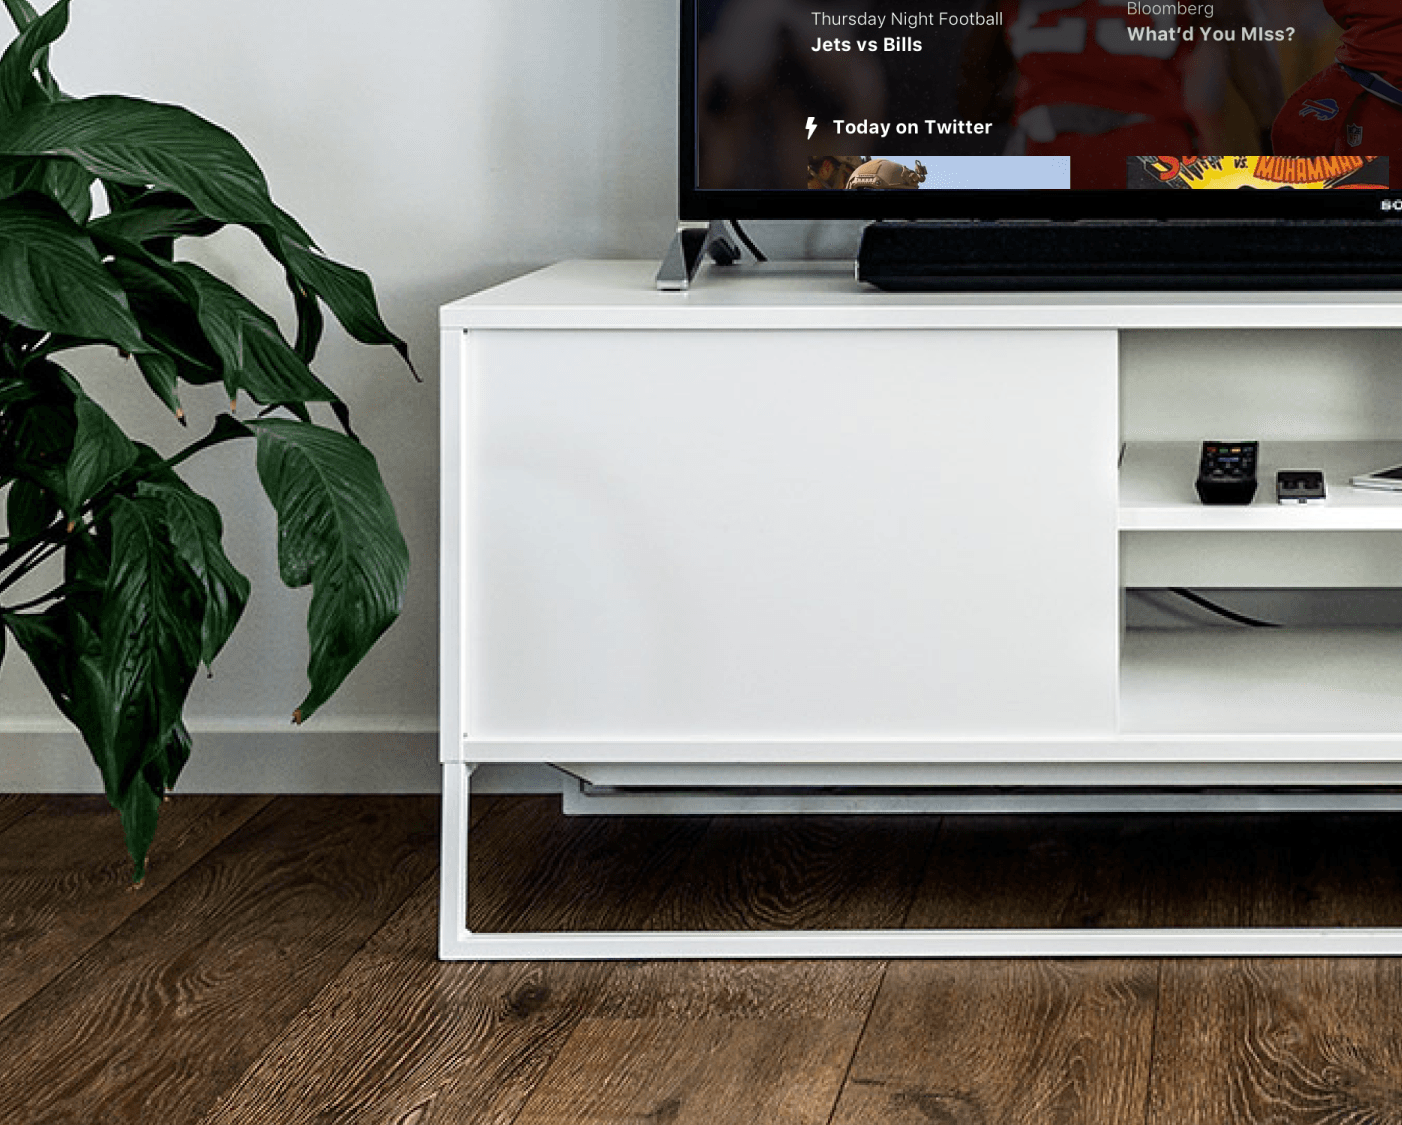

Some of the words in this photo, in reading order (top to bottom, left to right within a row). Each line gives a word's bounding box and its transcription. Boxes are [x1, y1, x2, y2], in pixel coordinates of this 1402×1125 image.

[1127, 1, 1214, 19] Bloomberg
[811, 11, 887, 29] Thursday
[891, 11, 934, 29] Night
[939, 11, 1003, 26] Football
[1127, 27, 1194, 42] What'd
[1199, 27, 1235, 42] You
[811, 37, 852, 52] Jets
[857, 40, 878, 52] vs
[883, 37, 923, 52] Bills
[832, 119, 891, 138] Today
[895, 122, 919, 135] on
[924, 119, 993, 135] Twitter
